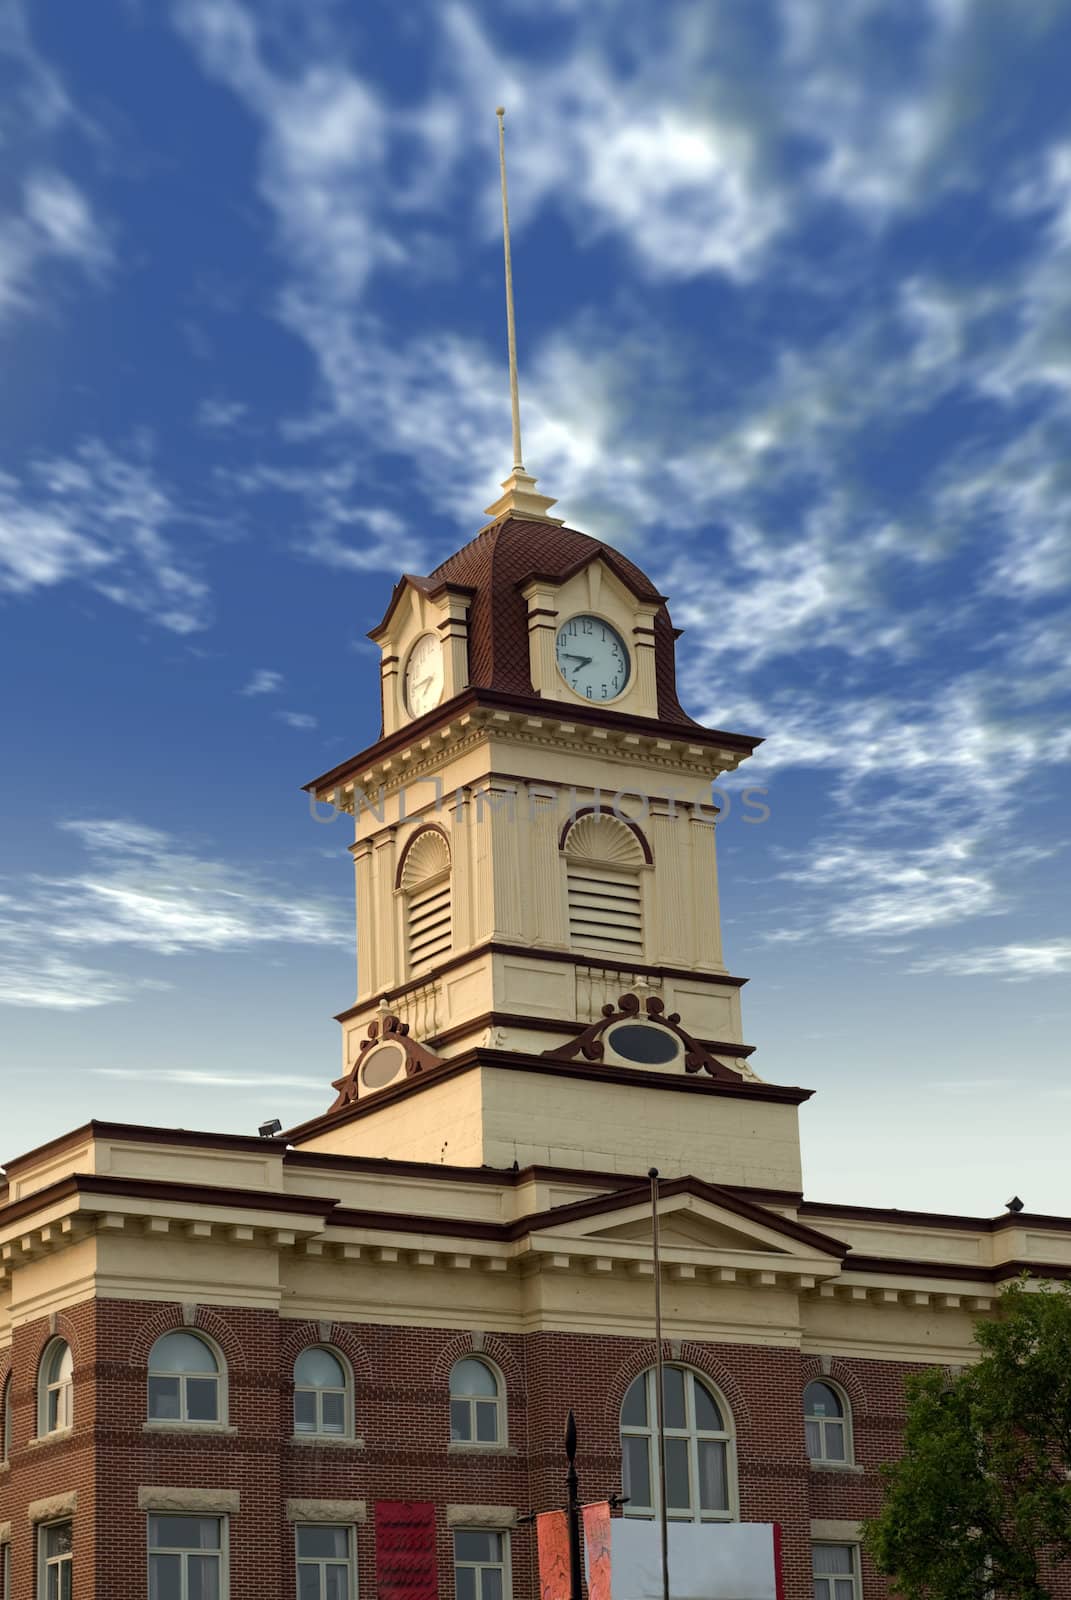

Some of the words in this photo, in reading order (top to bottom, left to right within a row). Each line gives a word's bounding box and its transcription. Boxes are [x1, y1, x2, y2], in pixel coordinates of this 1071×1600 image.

[568, 621, 577, 636] 11
[583, 620, 592, 635] 12
[601, 628, 605, 642] 1
[612, 643, 618, 656] 2
[617, 659, 623, 673] 3
[611, 676, 618, 690] 4
[586, 686, 592, 699] 6
[601, 684, 607, 698] 5
